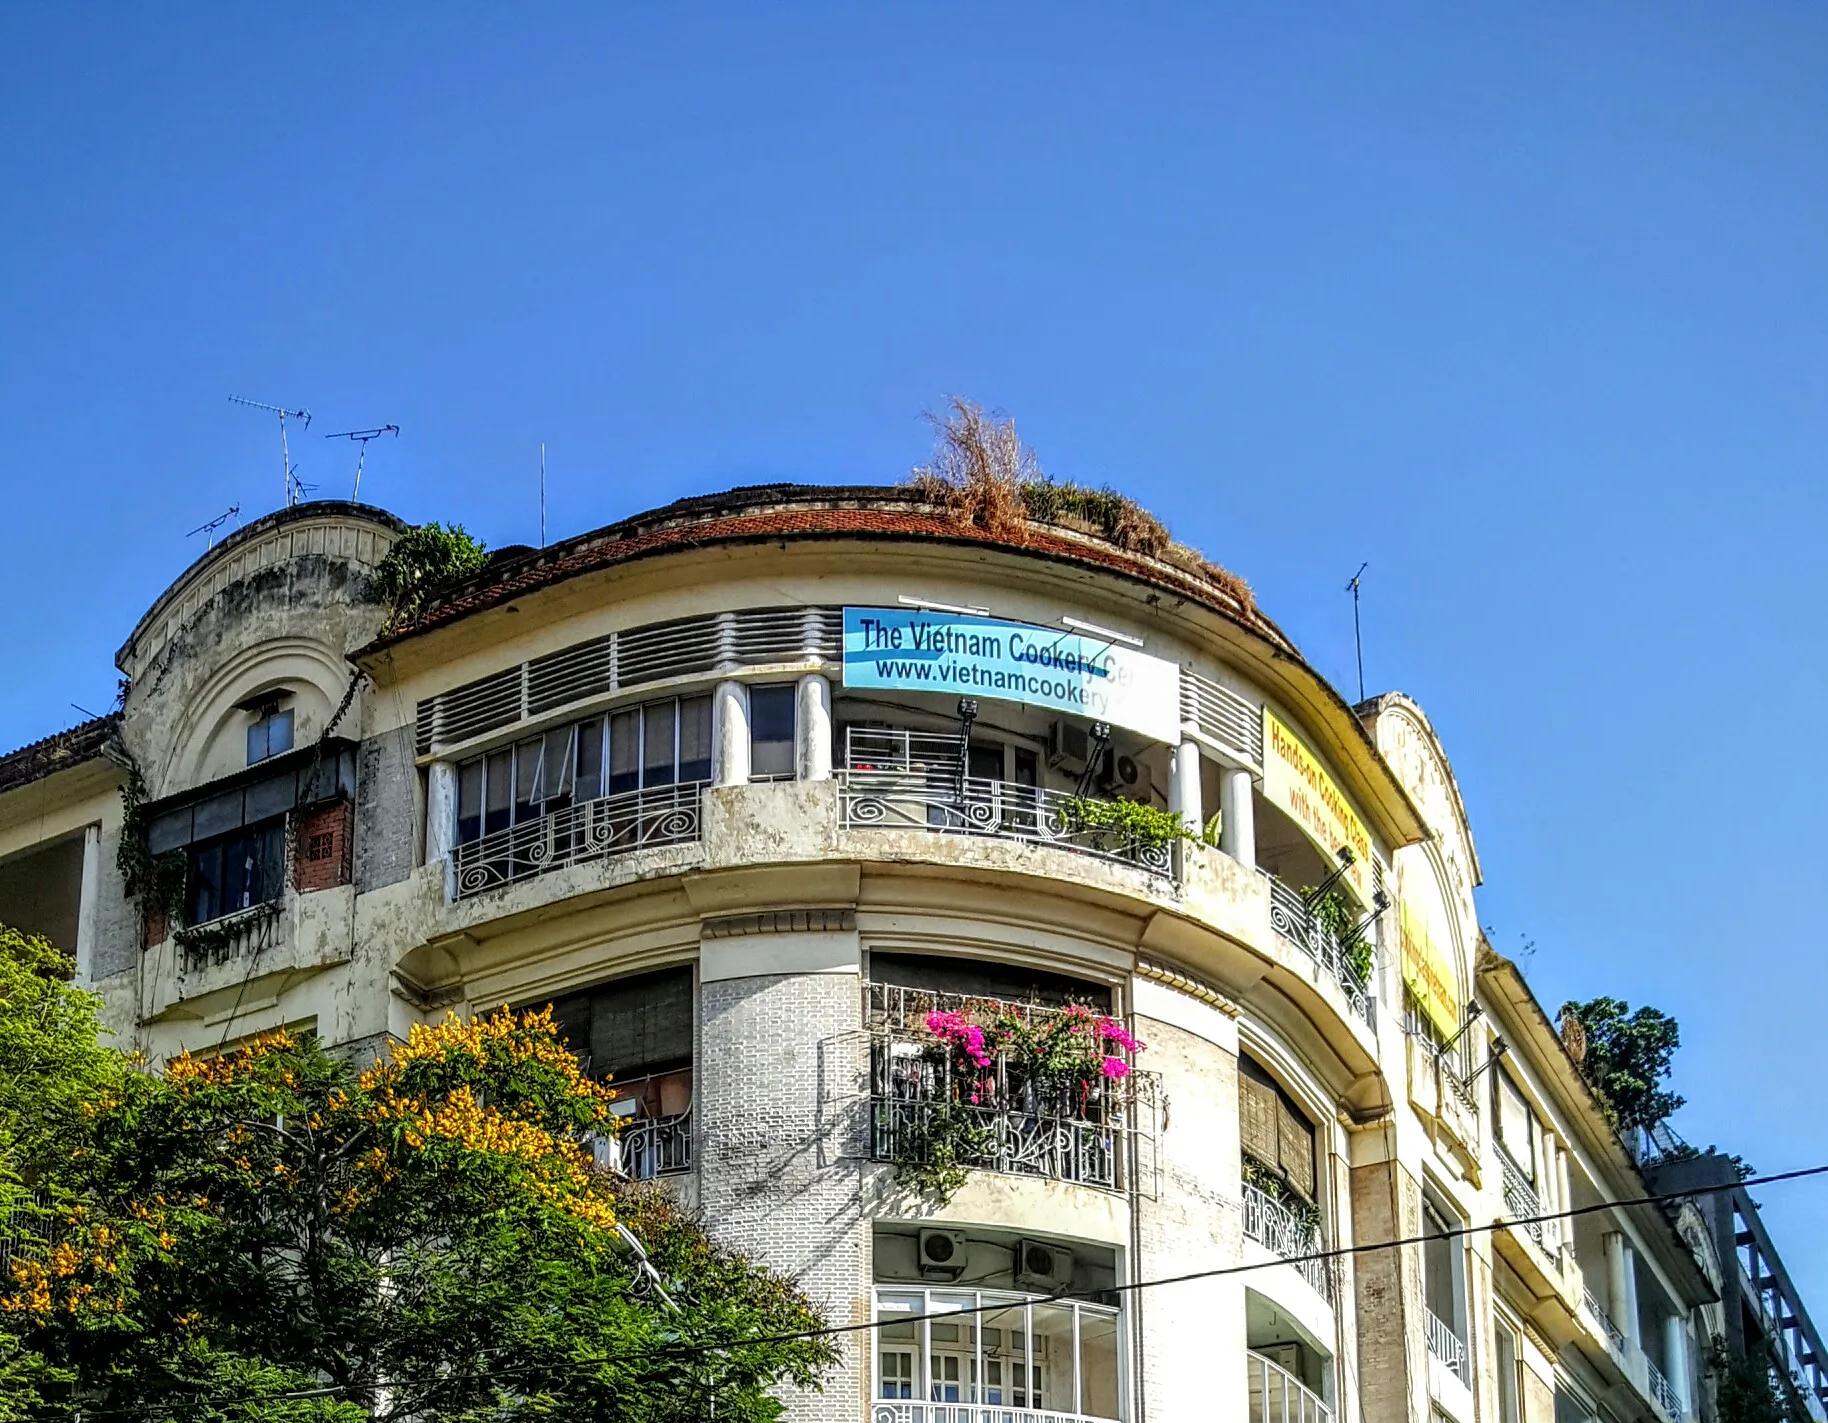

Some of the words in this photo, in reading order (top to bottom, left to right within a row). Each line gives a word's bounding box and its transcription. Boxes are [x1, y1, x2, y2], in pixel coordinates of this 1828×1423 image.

[860, 617, 903, 650] The
[911, 621, 1001, 660] Vietnam
[1008, 632, 1096, 685] Cookery
[1271, 719, 1318, 793] Hands-on
[1318, 771, 1350, 840] Cooking
[1350, 814, 1370, 864] Class
[1289, 786, 1312, 825] with
[1313, 806, 1328, 842] the
